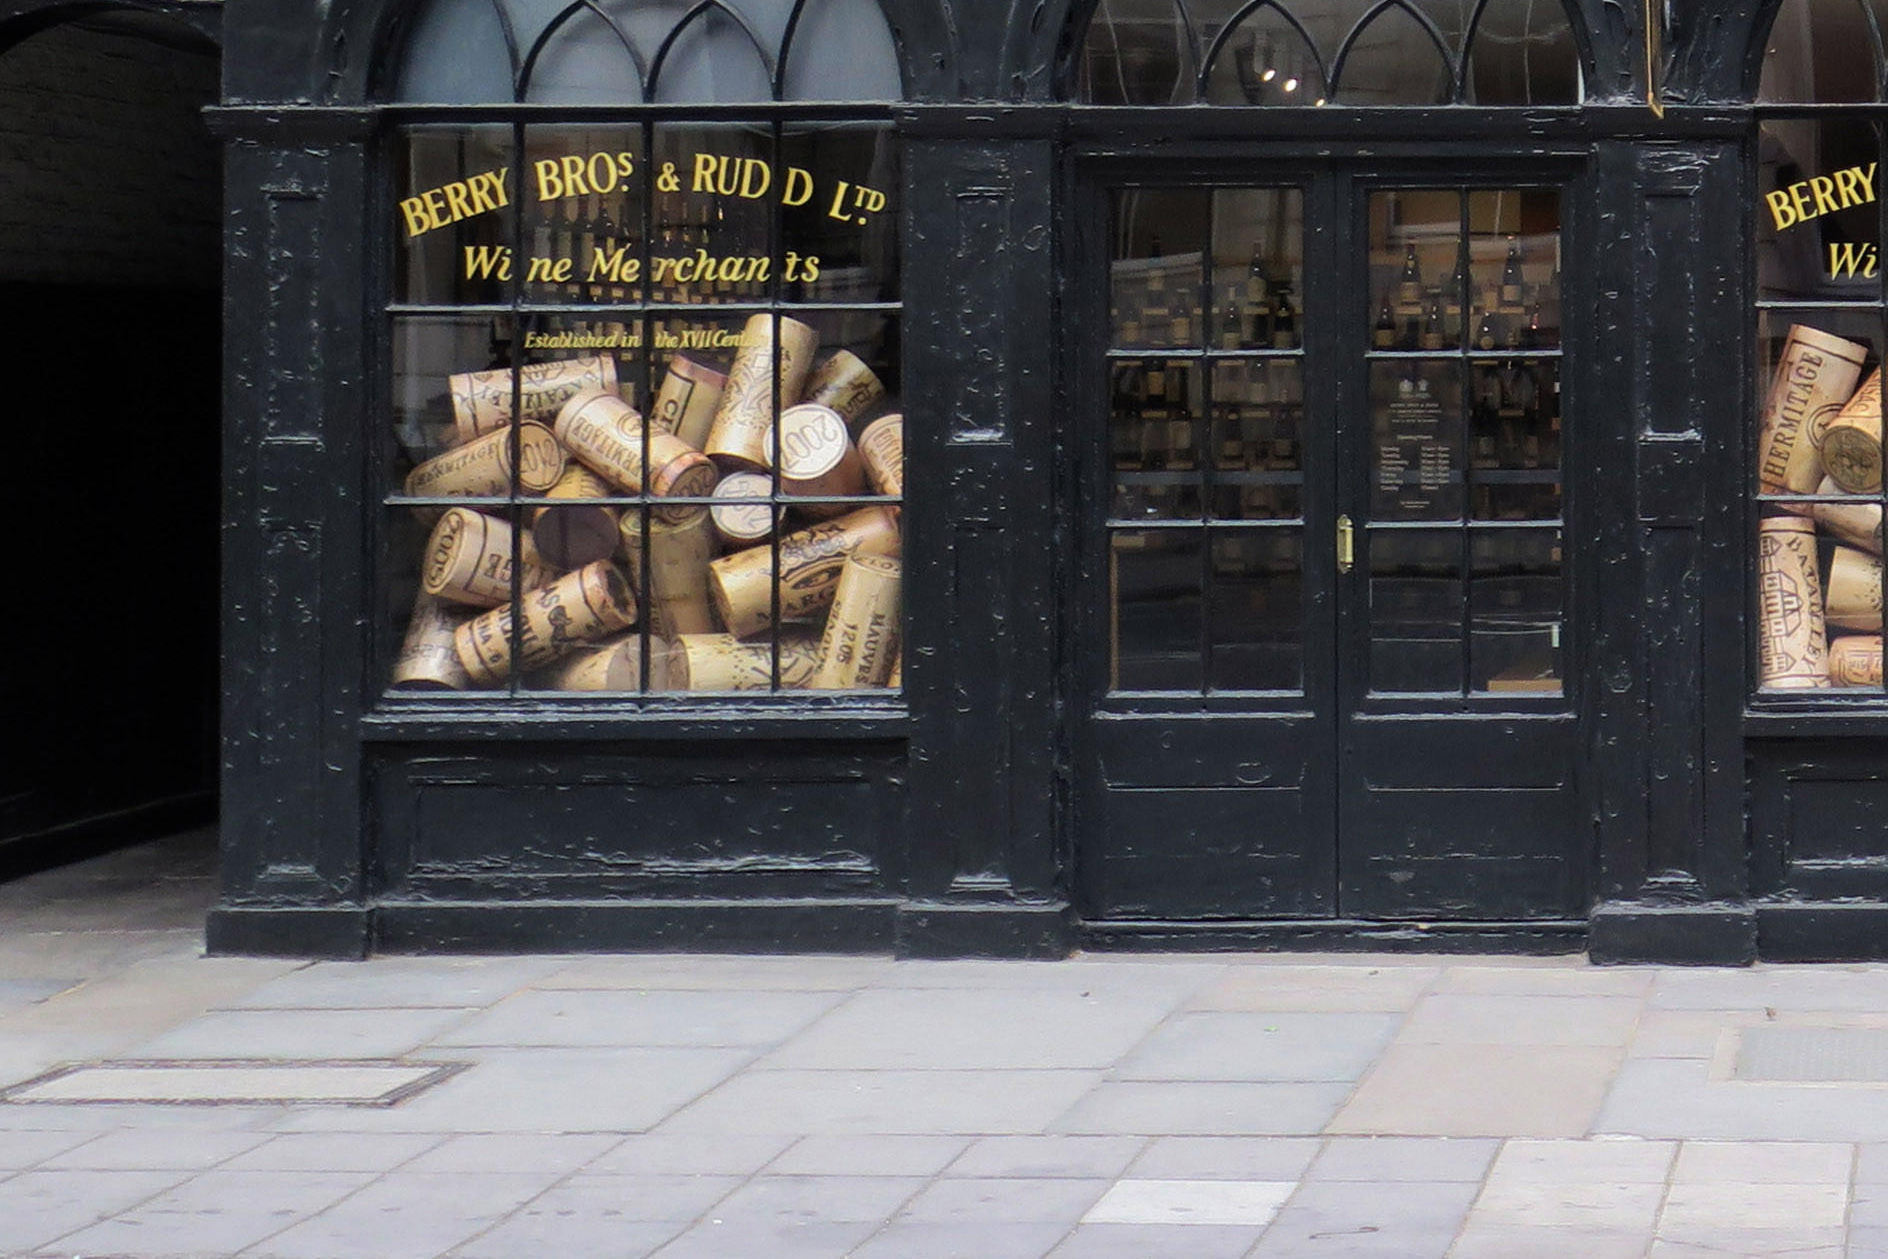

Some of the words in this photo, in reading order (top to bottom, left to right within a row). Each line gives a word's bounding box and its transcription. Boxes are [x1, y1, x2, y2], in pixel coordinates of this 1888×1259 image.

[400, 168, 508, 236] BERRY
[657, 162, 680, 192] &
[692, 153, 814, 205] RUDD
[1766, 163, 1877, 230] BERRY
[465, 246, 572, 282] Wine
[587, 243, 820, 282] Merchants
[524, 331, 617, 348] Established
[620, 332, 640, 348] in
[654, 332, 678, 348] the
[679, 330, 711, 349] XVII
[1763, 350, 1824, 479] HERMITAGE
